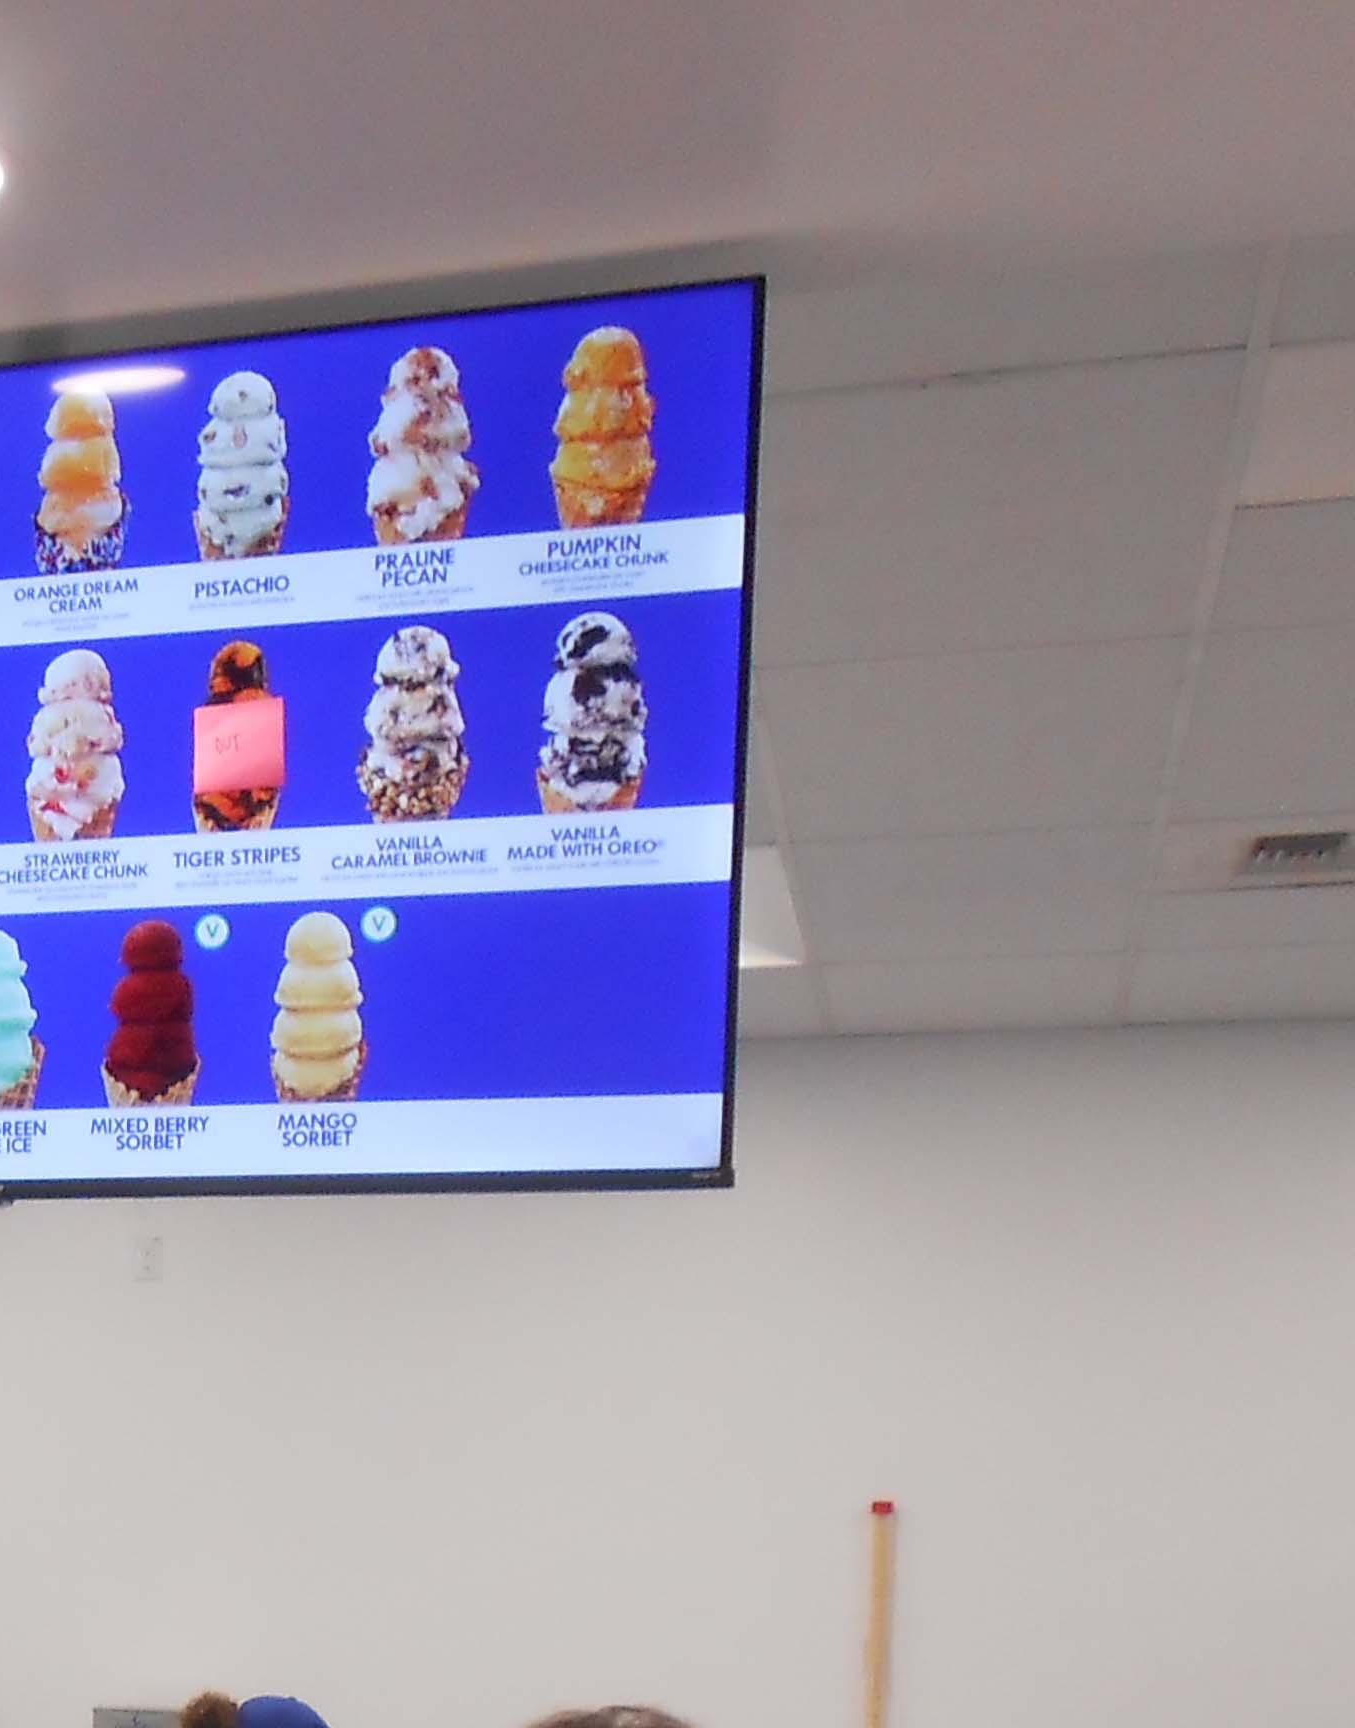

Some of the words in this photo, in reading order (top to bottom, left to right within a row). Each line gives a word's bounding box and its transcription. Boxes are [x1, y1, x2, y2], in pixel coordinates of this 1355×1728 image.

[547, 534, 642, 558] PUMPKIN
[375, 547, 455, 571] PRALINE
[519, 555, 610, 576] CHEESECAKE
[614, 551, 668, 568] CHUNK
[194, 575, 290, 598] PISTACHIO
[382, 567, 448, 587] PECAN
[14, 584, 80, 602] ORANGE
[83, 578, 138, 595] DREAM
[49, 597, 103, 614] CREAM
[551, 825, 620, 842] VANILLA
[375, 835, 443, 852] VANILLA
[507, 845, 556, 861] MADE
[562, 841, 603, 857] WITH
[24, 850, 120, 868] STRAWBERRY
[173, 850, 224, 868] TIGER
[230, 846, 301, 865] STRIPES
[331, 851, 408, 870] CARAMEL
[413, 849, 487, 866] BROWNIE
[93, 863, 148, 878] CHUNK
[91, 1118, 148, 1135] MIXED
[154, 1116, 209, 1133] BERRY
[278, 1113, 357, 1130] MANGO
[6, 1137, 32, 1153] ICE
[116, 1134, 184, 1150] SORBET
[282, 1130, 353, 1147] SORBET
